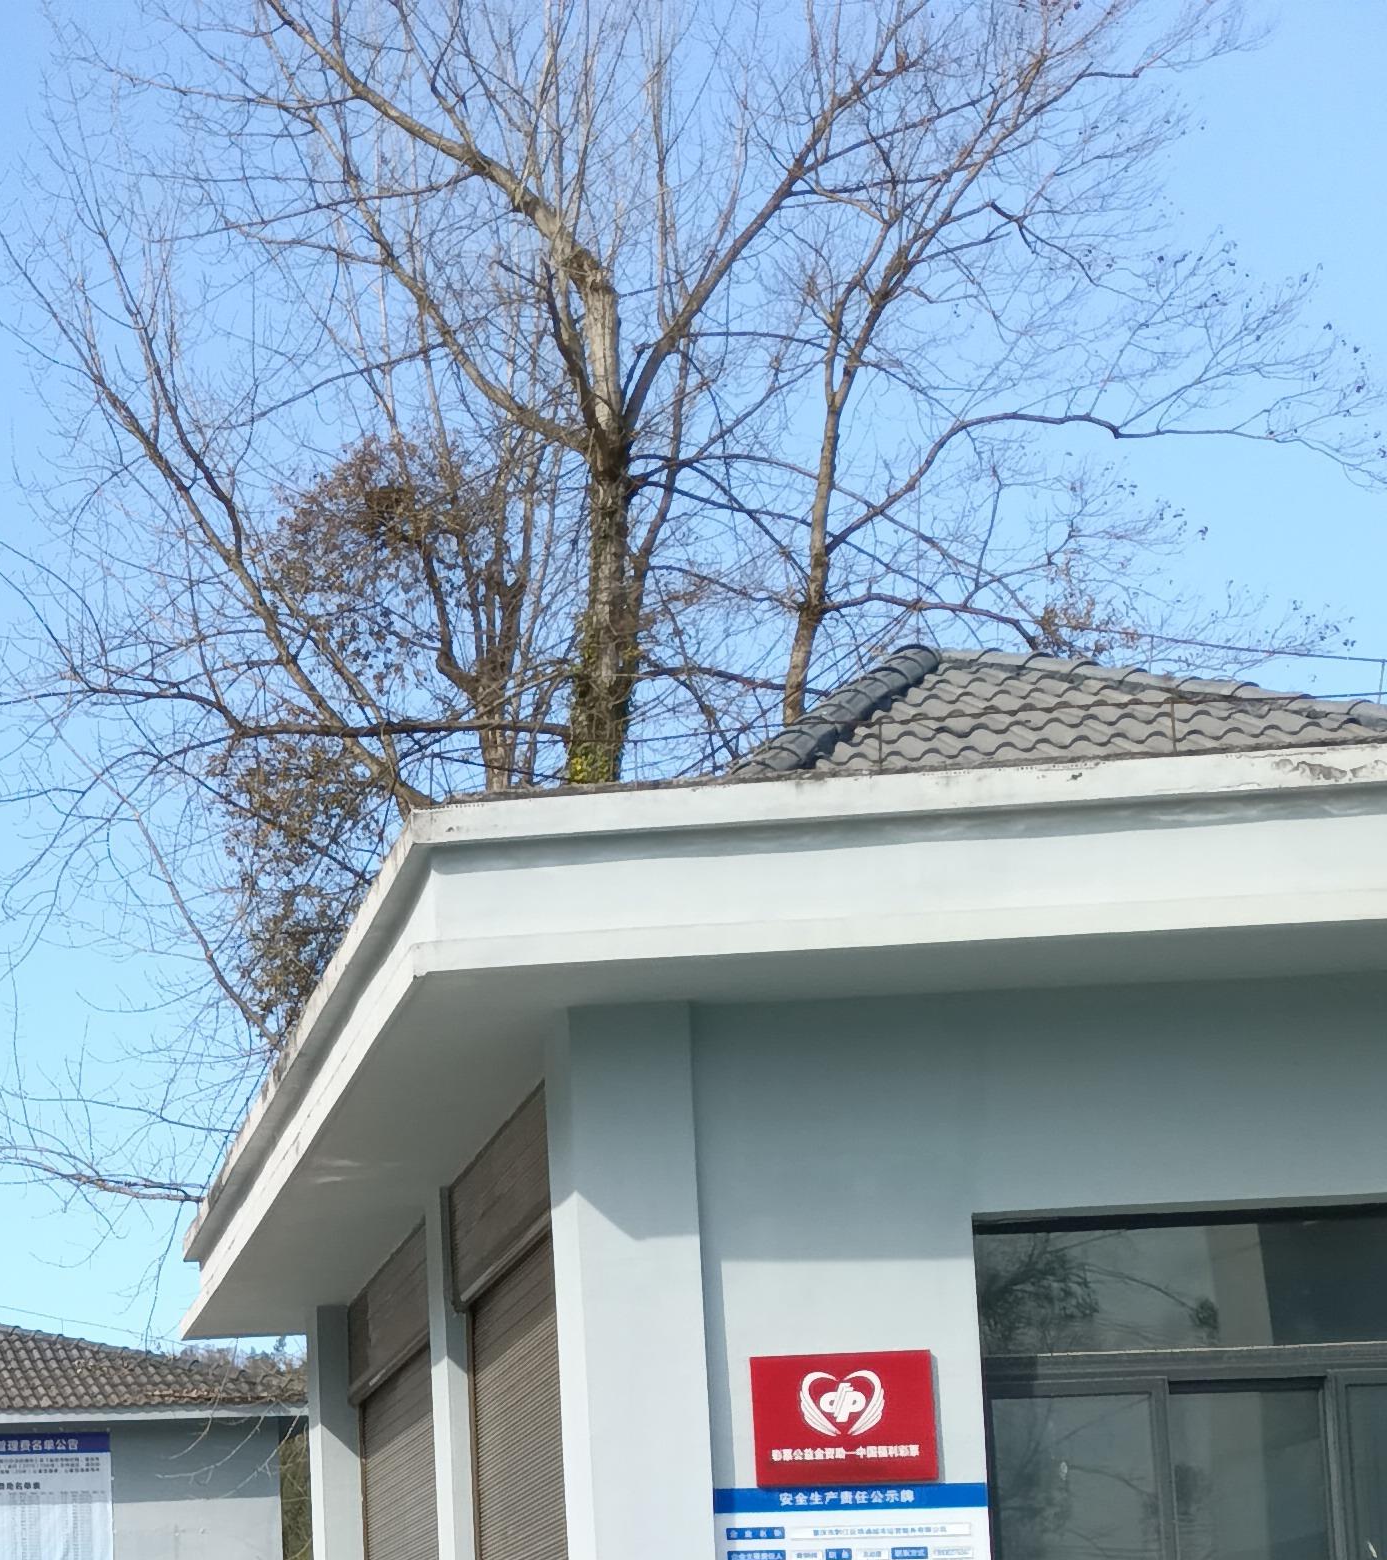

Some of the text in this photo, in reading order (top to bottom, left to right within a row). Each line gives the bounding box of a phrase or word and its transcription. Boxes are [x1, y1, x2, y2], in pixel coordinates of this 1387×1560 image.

[778, 1489, 916, 1507] 安全生产责任公示牌
